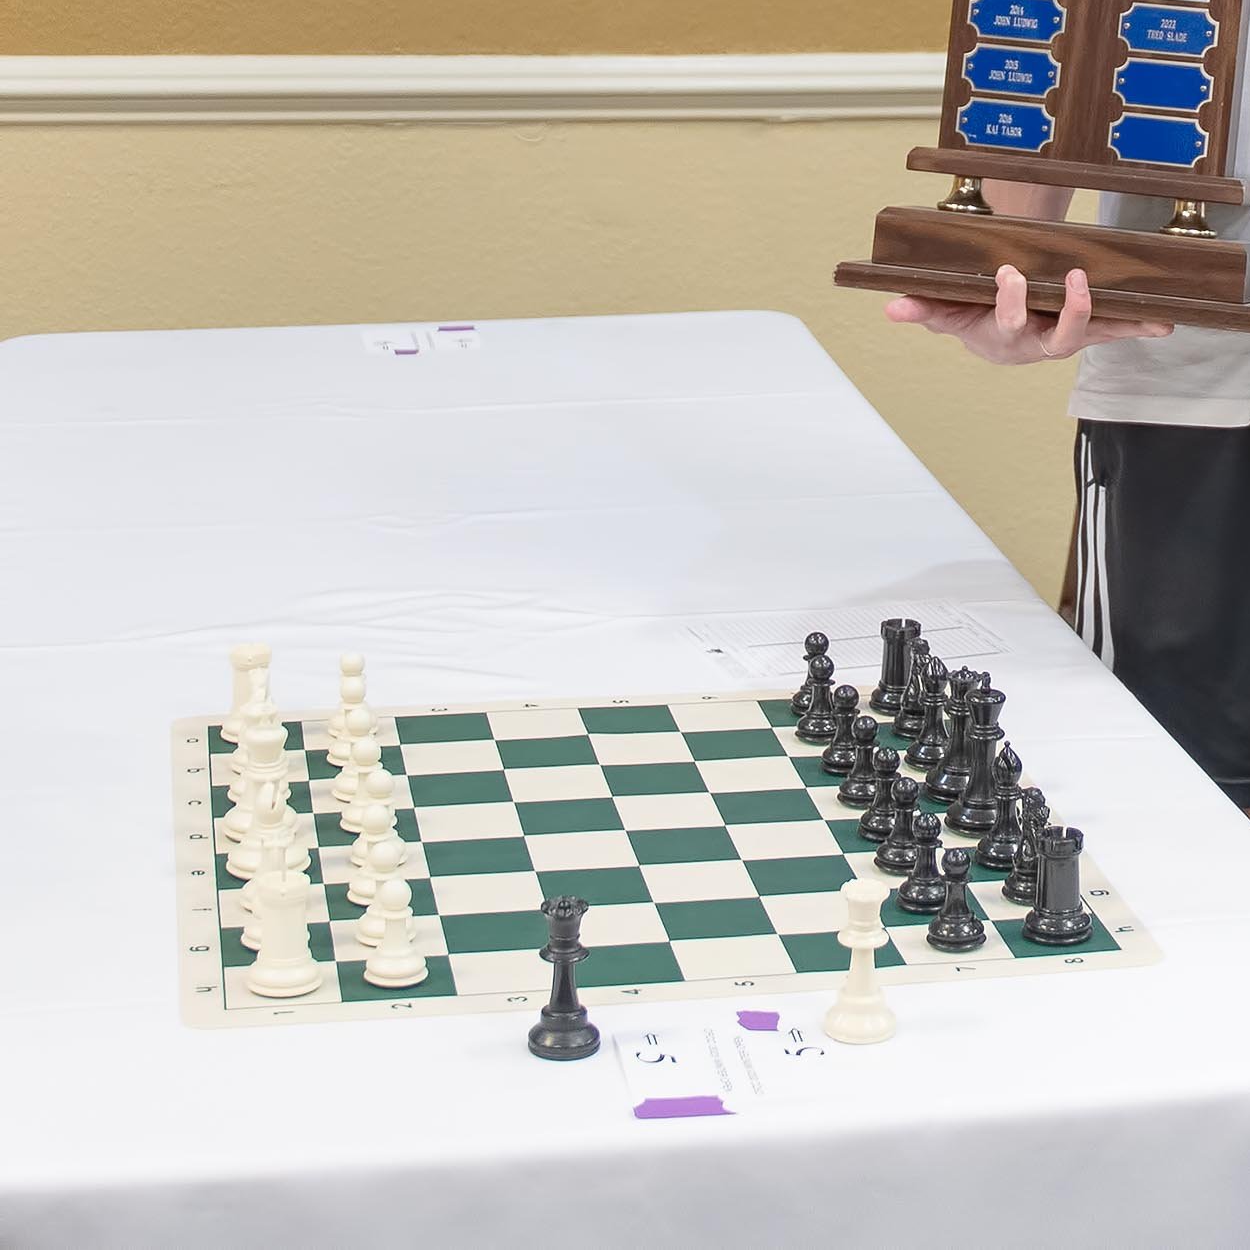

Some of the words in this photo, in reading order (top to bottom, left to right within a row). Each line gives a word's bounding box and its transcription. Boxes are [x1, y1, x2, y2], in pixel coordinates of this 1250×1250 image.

[993, 15, 1012, 27] JOHN
[1013, 16, 1039, 29] LUDWIG
[1146, 28, 1165, 40] THEO
[1166, 30, 1189, 43] SLADE
[988, 69, 1006, 81] JOHN
[1008, 71, 1033, 84] LUDWIG
[985, 123, 999, 135] KAI
[190, 869, 206, 877] e
[1114, 924, 1135, 934] h
[1064, 956, 1085, 965] 8
[733, 979, 756, 987] 5
[620, 987, 642, 996] 4
[506, 995, 528, 1003] 3
[784, 1046, 826, 1057] 5
[635, 1051, 677, 1064] 5
